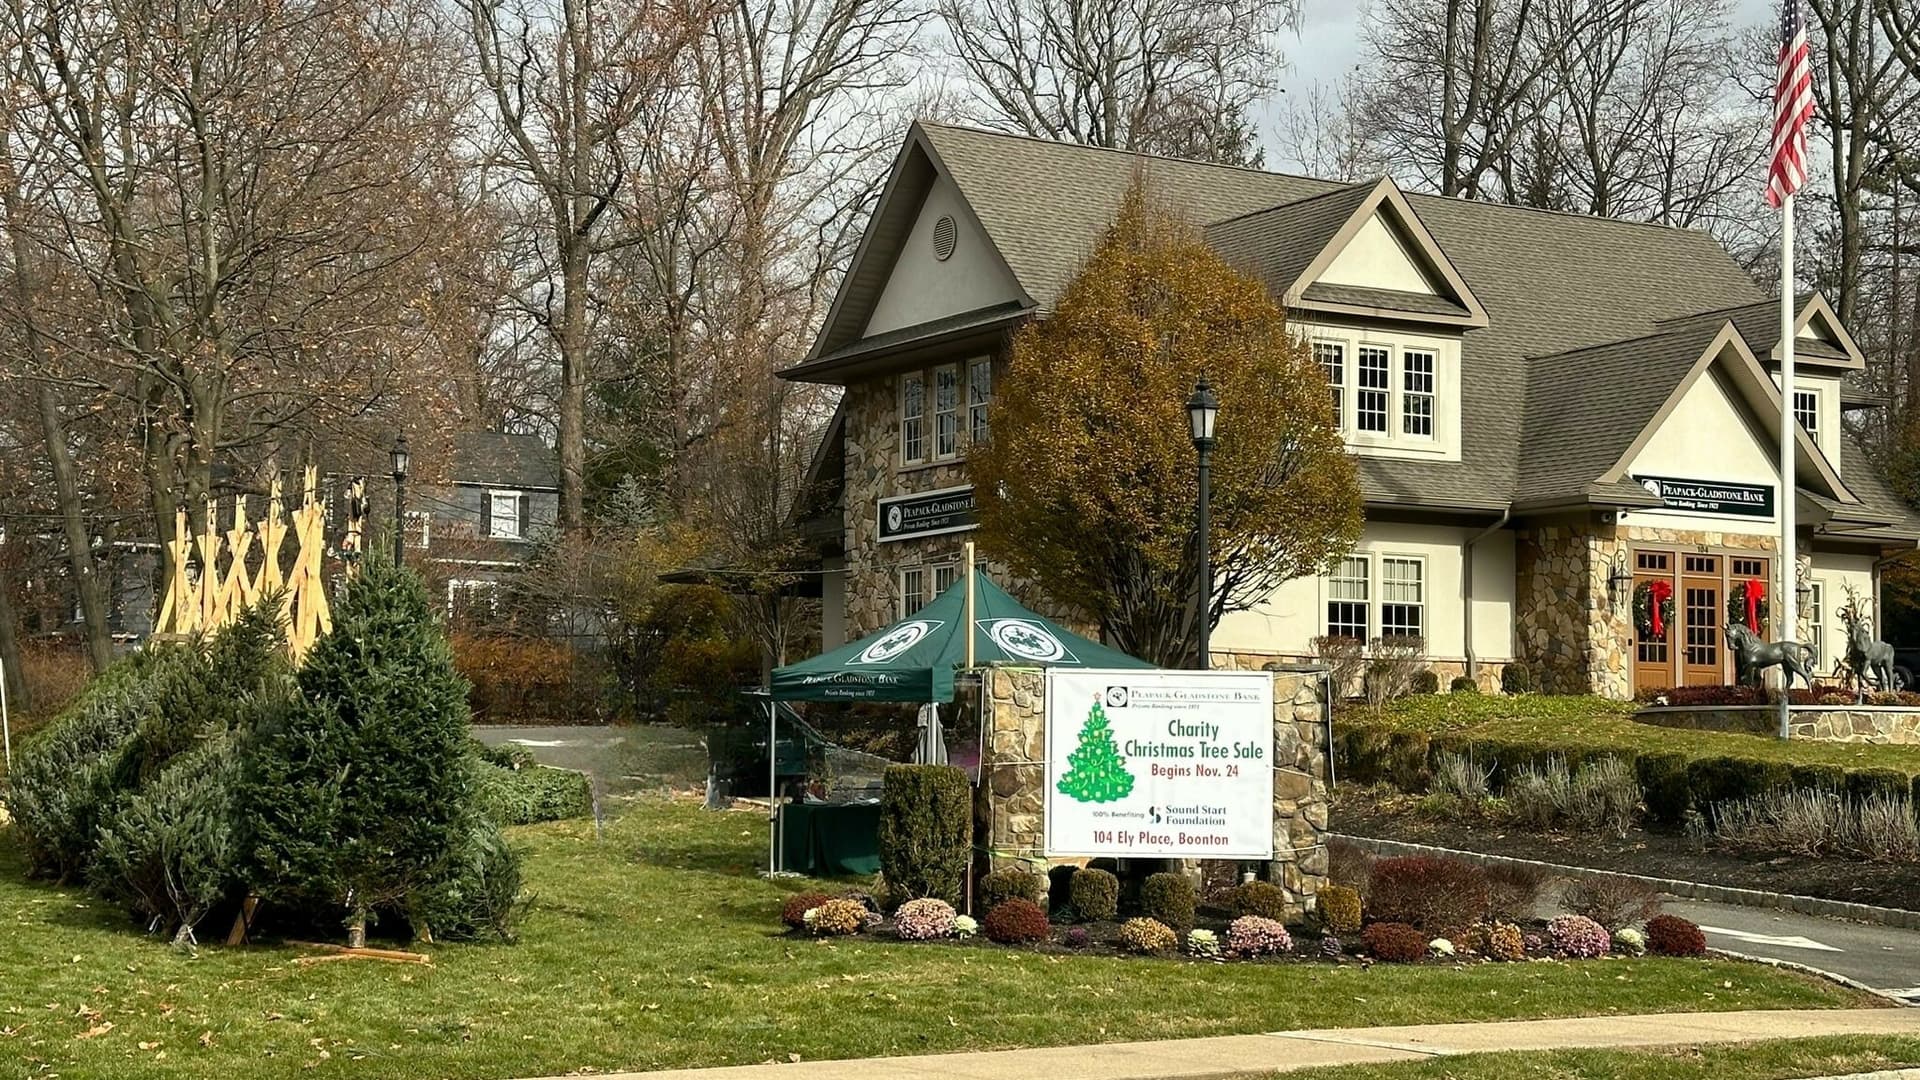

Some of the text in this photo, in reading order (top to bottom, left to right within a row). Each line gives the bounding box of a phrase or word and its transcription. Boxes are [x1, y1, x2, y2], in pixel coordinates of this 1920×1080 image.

[1662, 484, 1764, 502] PEAPACK-GLADSTONE BANK
[1131, 690, 1260, 701] PEAPACKGLADSTONE BANK
[1168, 719, 1219, 741] Charity
[1125, 740, 1263, 759] Christmas Tree Sale
[1151, 763, 1239, 779] Begins Nov. 24
[1111, 811, 1145, 819] Benefiting
[1165, 804, 1226, 815] Sound Start
[1166, 815, 1226, 825] Foundation
[1093, 830, 1229, 847] 104 Ely Place, Boonton
